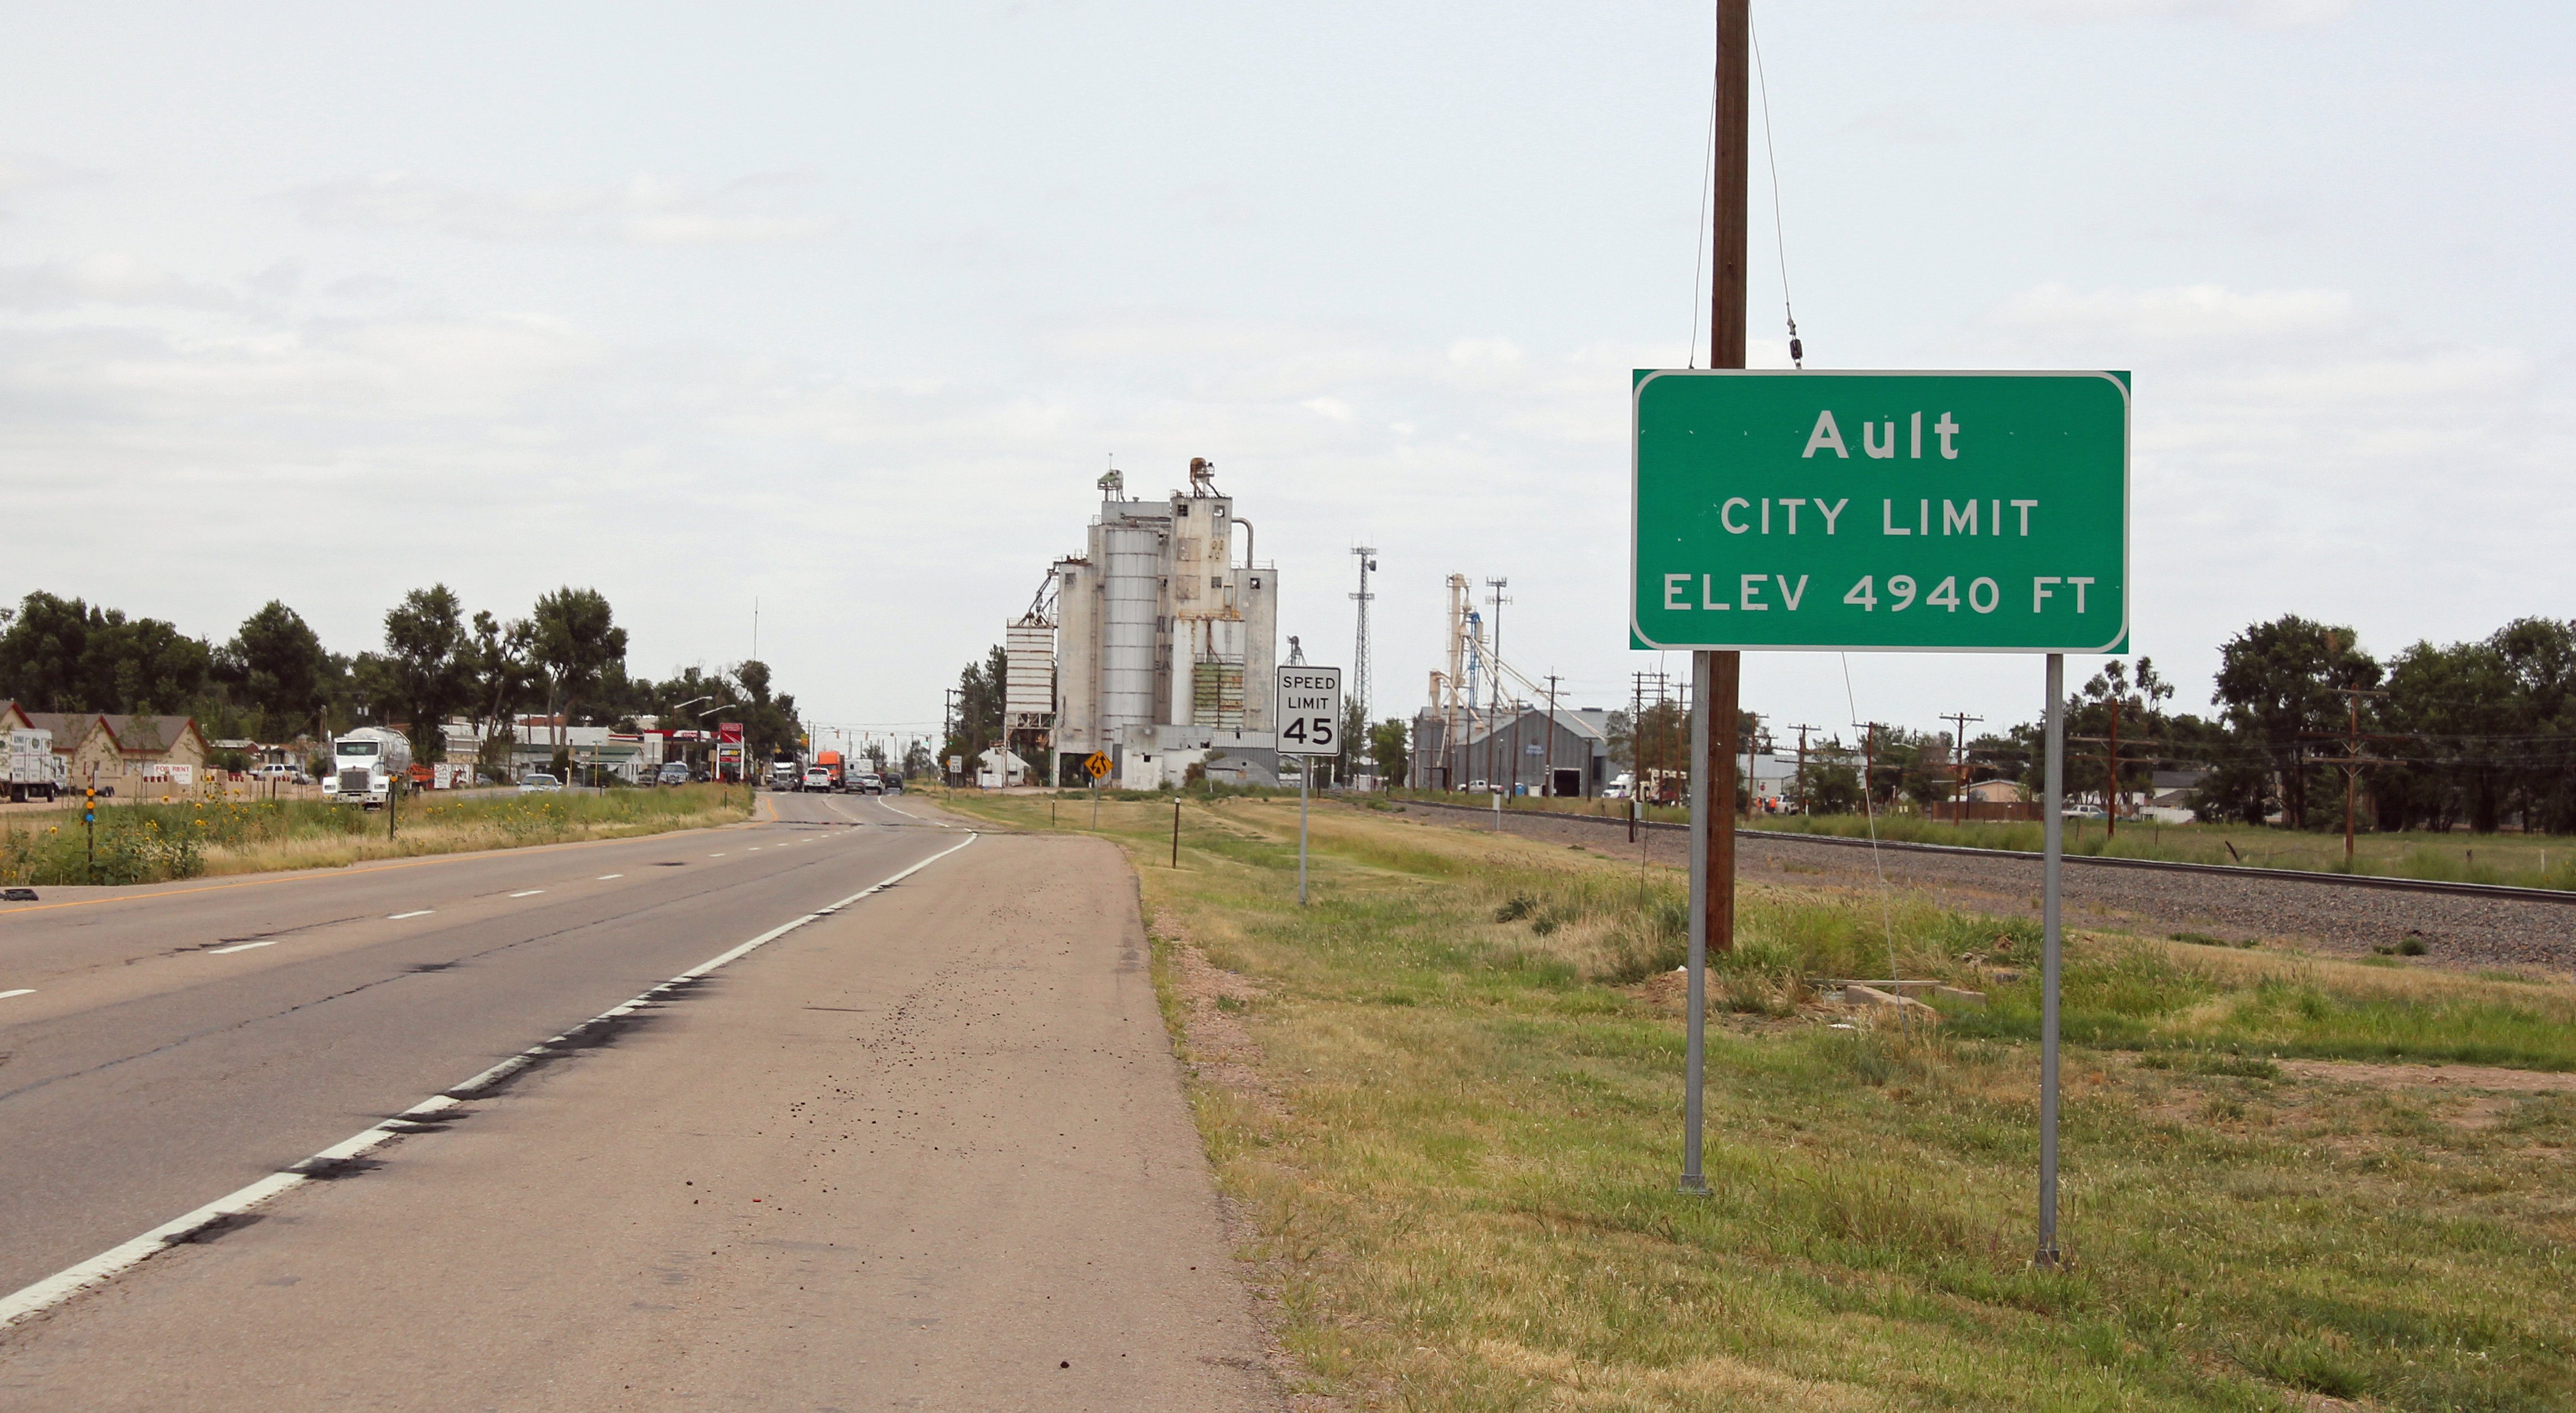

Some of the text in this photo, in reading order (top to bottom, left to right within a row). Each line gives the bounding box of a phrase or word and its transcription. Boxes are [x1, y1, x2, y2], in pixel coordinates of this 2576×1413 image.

[1802, 410, 1959, 460] Ault
[1721, 497, 2038, 536] CITY LIMIT
[1664, 573, 2095, 614] ELEV 4940 FT
[1284, 676, 1335, 689] SPEED
[1288, 697, 1329, 710] LIMIT
[1283, 717, 1333, 745] 45
